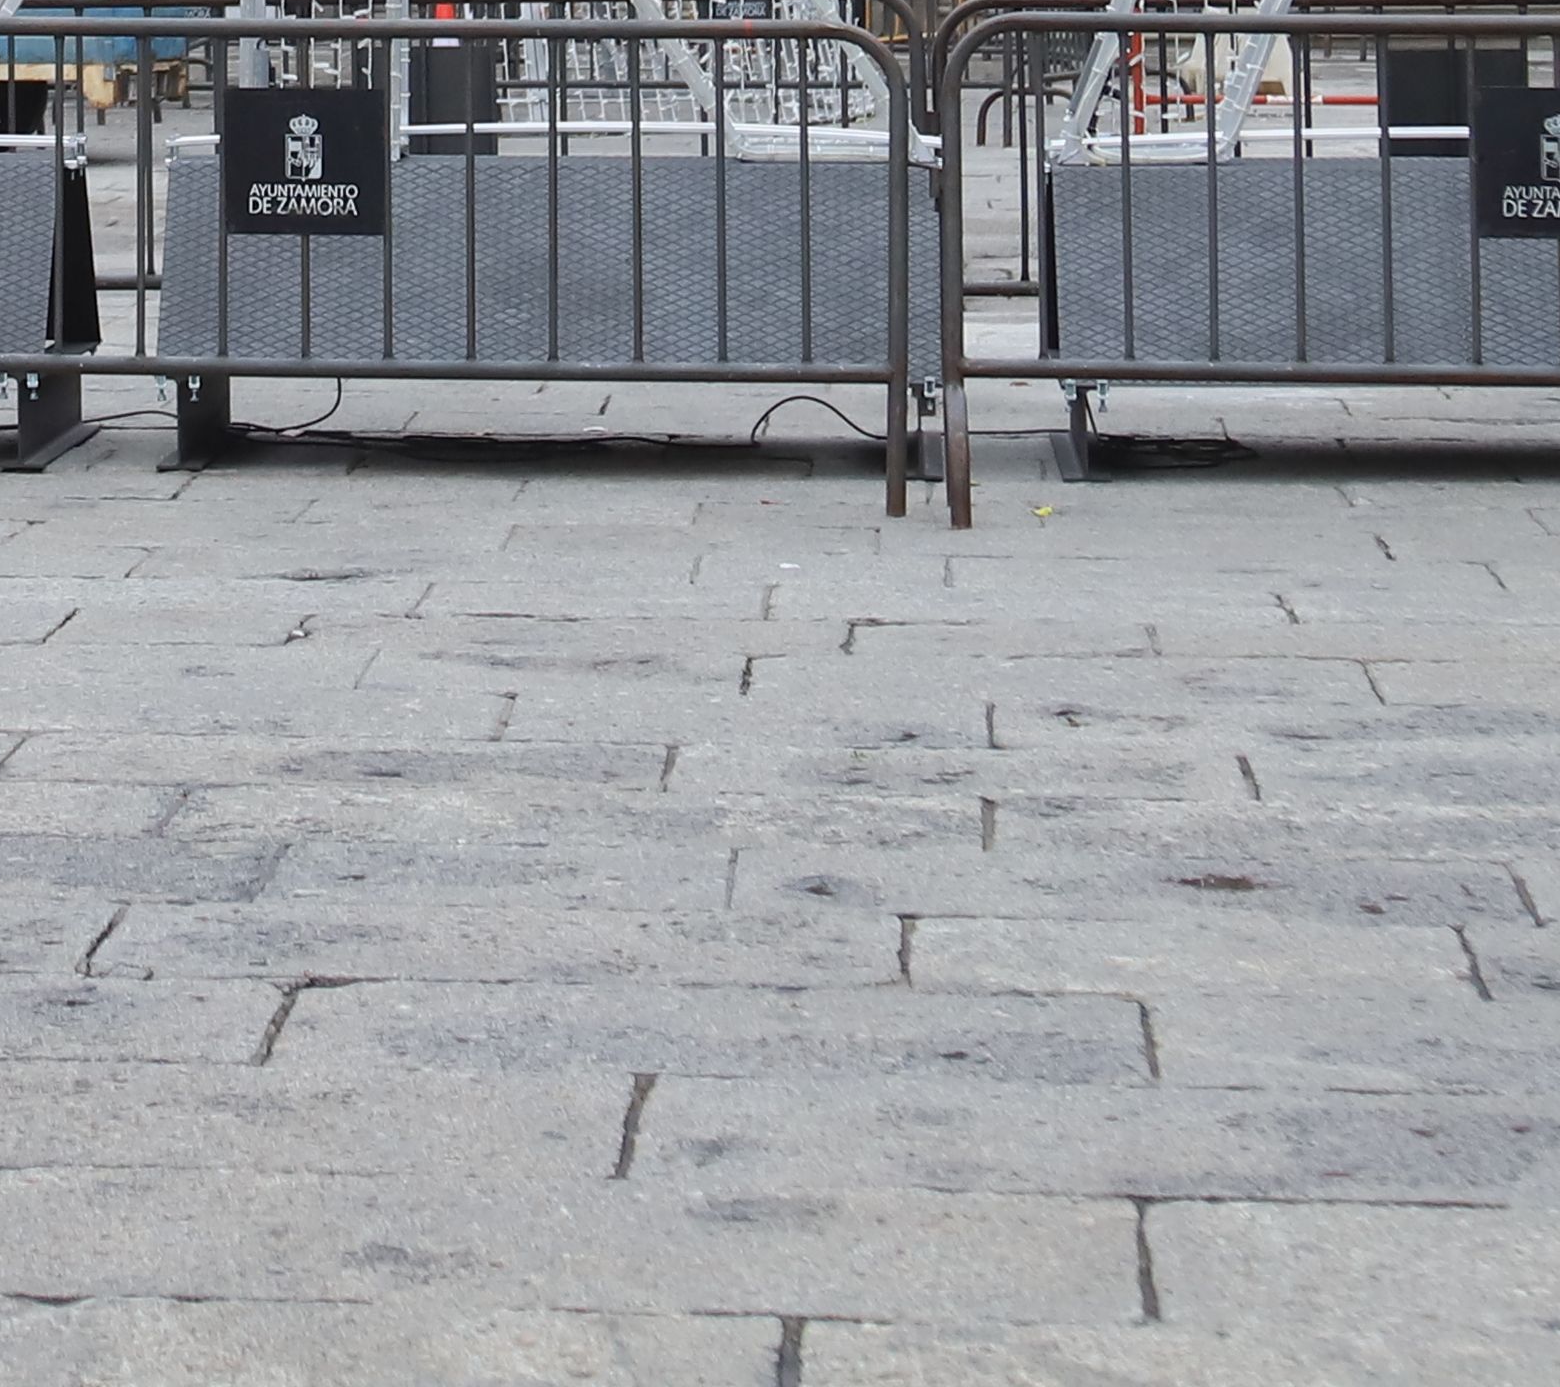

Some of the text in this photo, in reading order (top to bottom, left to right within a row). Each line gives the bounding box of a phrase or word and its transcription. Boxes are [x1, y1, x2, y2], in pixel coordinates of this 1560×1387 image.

[249, 183, 358, 198] AYUNTAMIENTO
[249, 197, 358, 216] DE ZAMORA
[1502, 199, 1528, 218] DE
